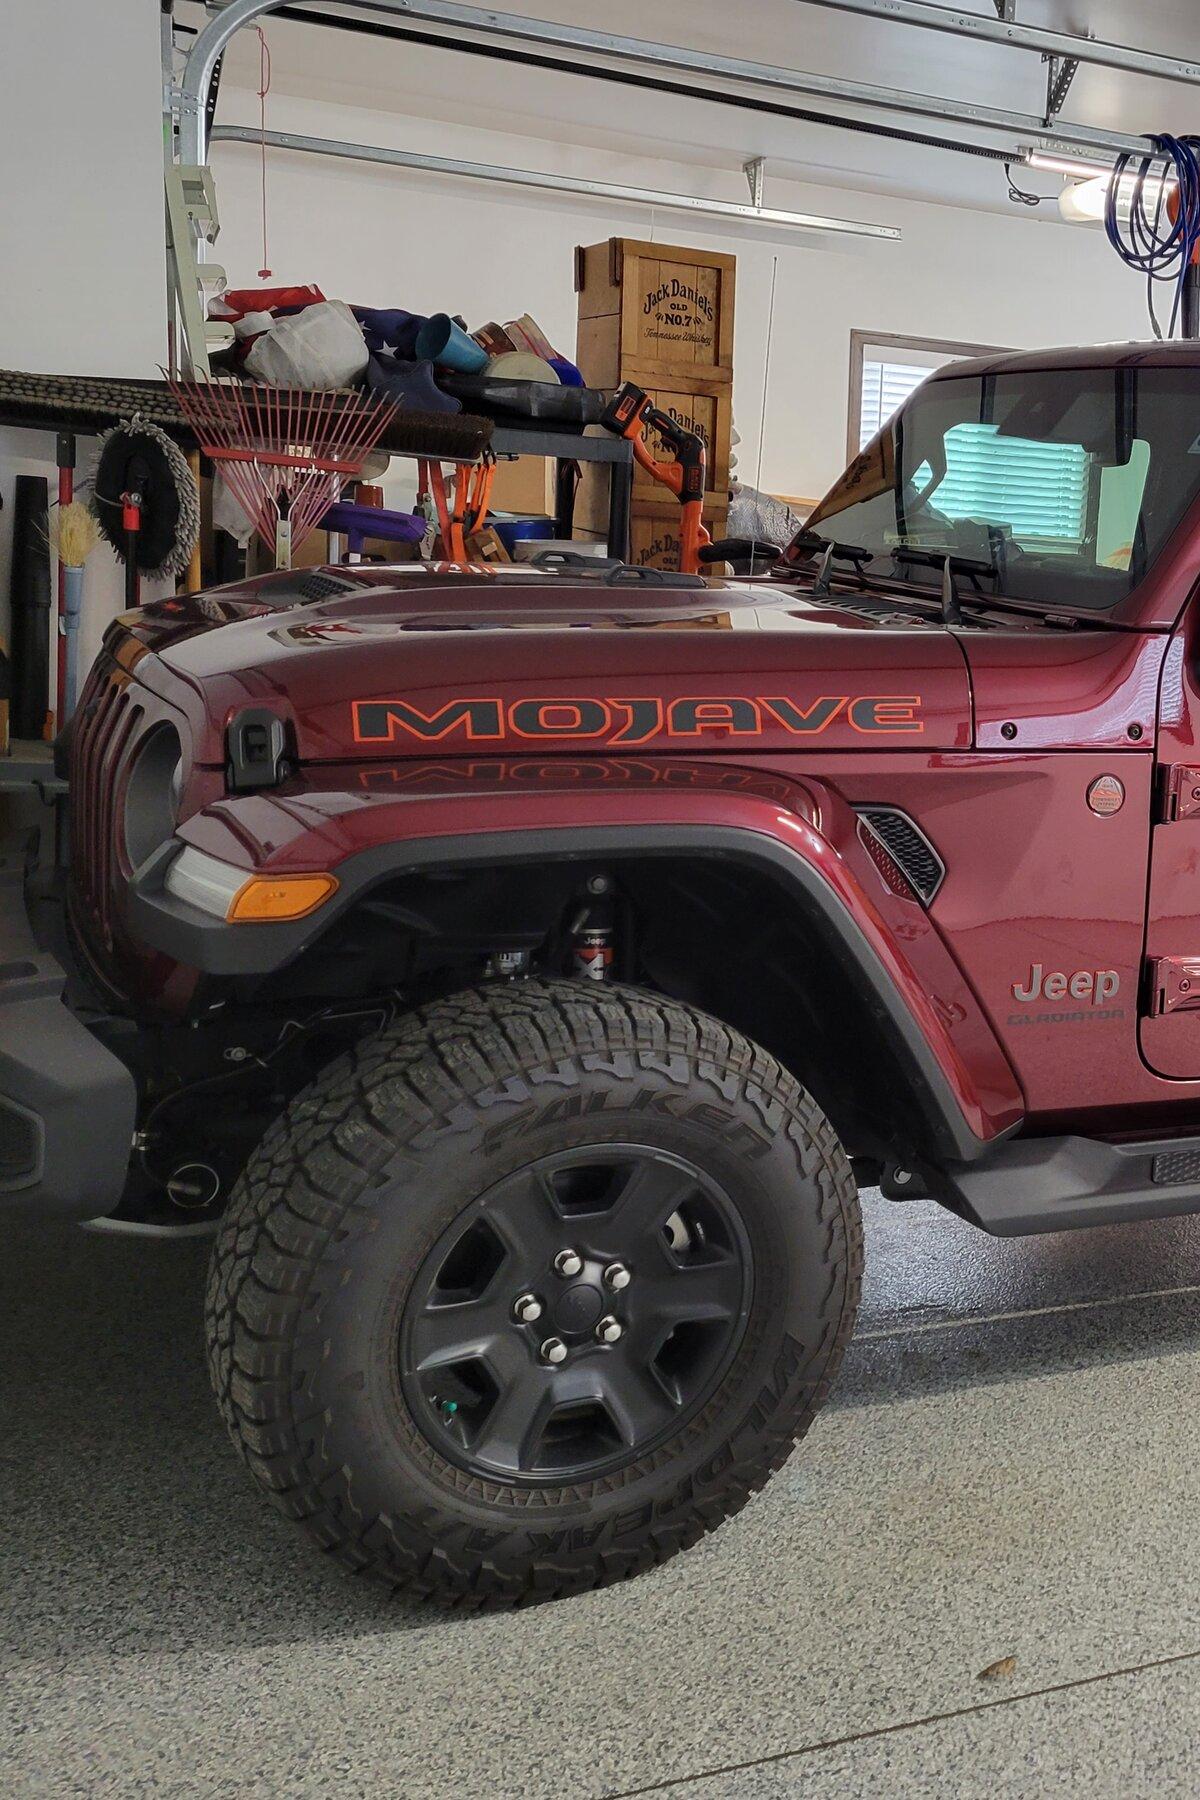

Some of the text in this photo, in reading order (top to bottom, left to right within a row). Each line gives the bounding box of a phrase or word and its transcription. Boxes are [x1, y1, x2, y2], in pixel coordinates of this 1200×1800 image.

[644, 278, 713, 321] Jack Daniel's
[670, 303, 688, 311] OLD
[644, 328, 713, 347] Tennessee Whiskey
[352, 696, 924, 745] MOJAVE
[1011, 963, 1120, 1006] Jeep
[1006, 1009, 1125, 1026] GLADIATOR
[478, 1088, 773, 1158] FALKEN
